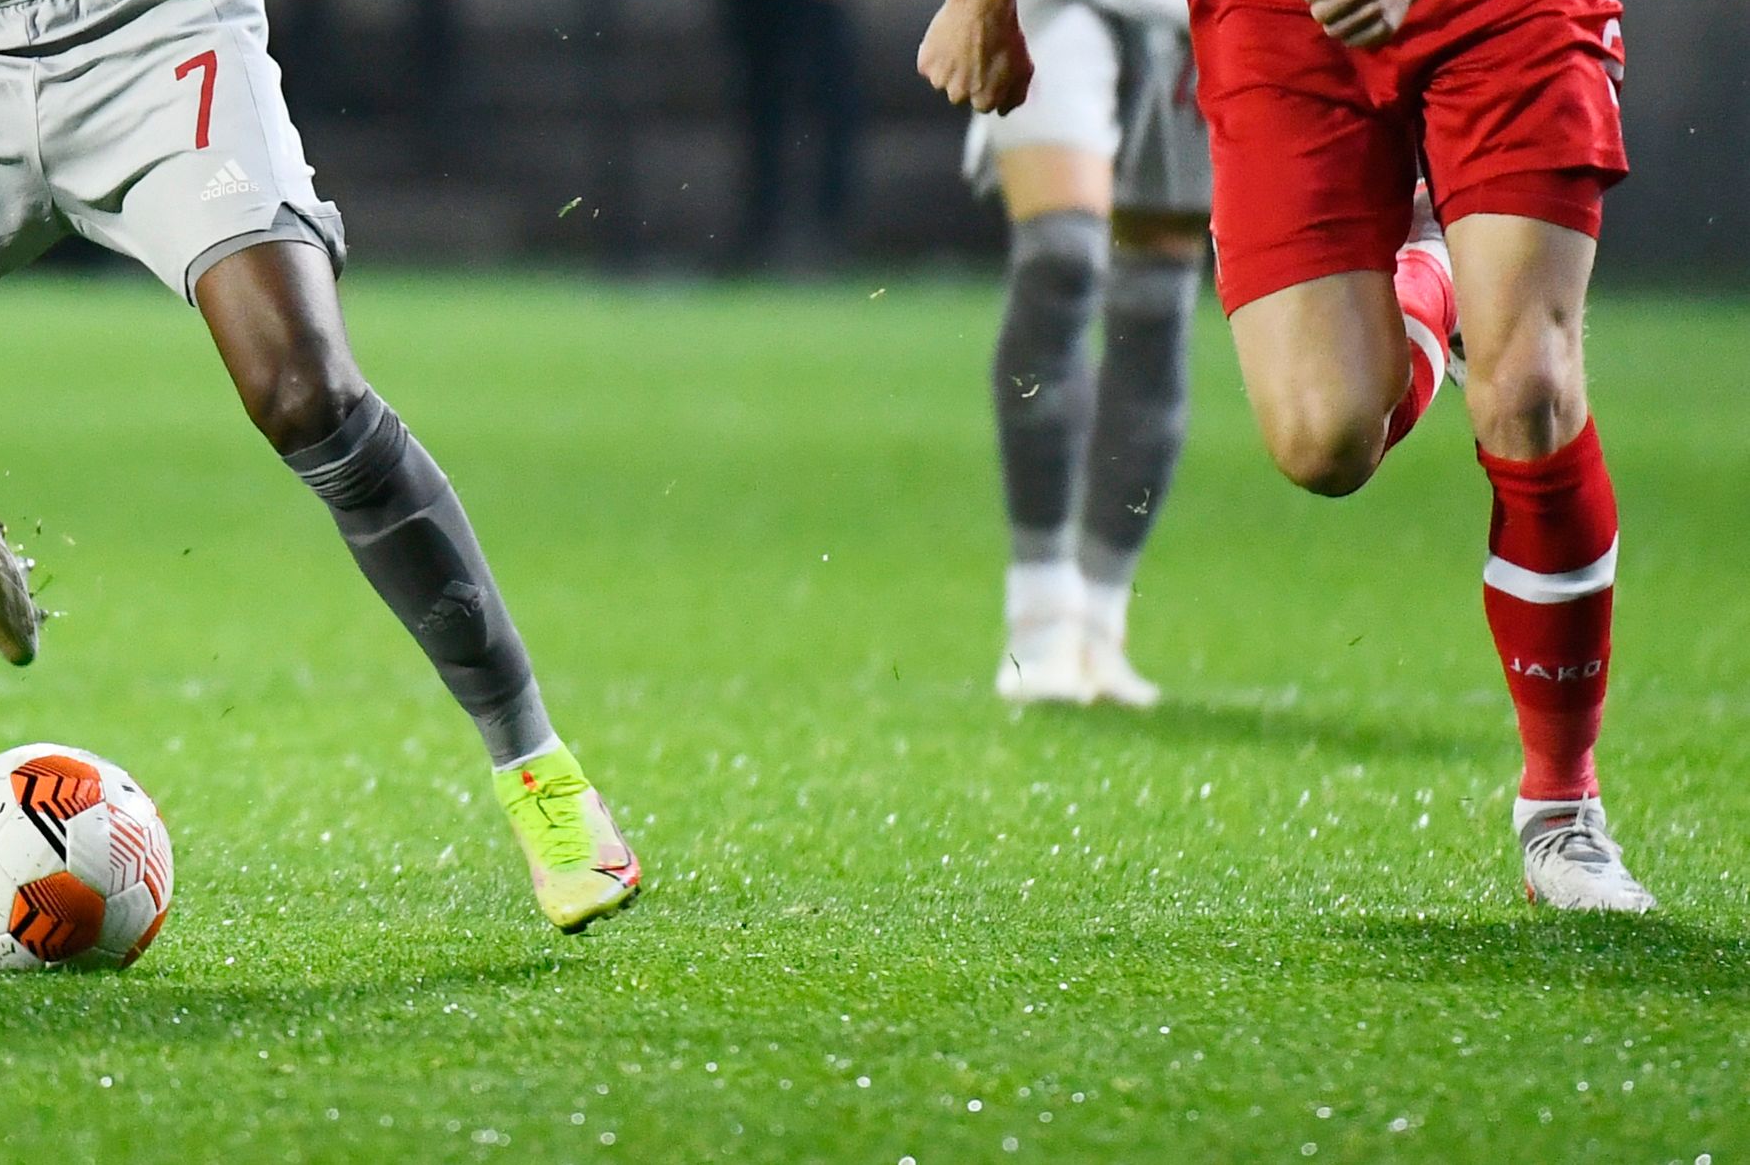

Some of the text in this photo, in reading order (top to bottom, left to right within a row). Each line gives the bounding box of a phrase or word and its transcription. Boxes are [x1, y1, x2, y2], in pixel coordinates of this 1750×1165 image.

[174, 49, 218, 150] 7
[200, 180, 259, 202] adidas
[1510, 657, 1602, 682] JAKO
